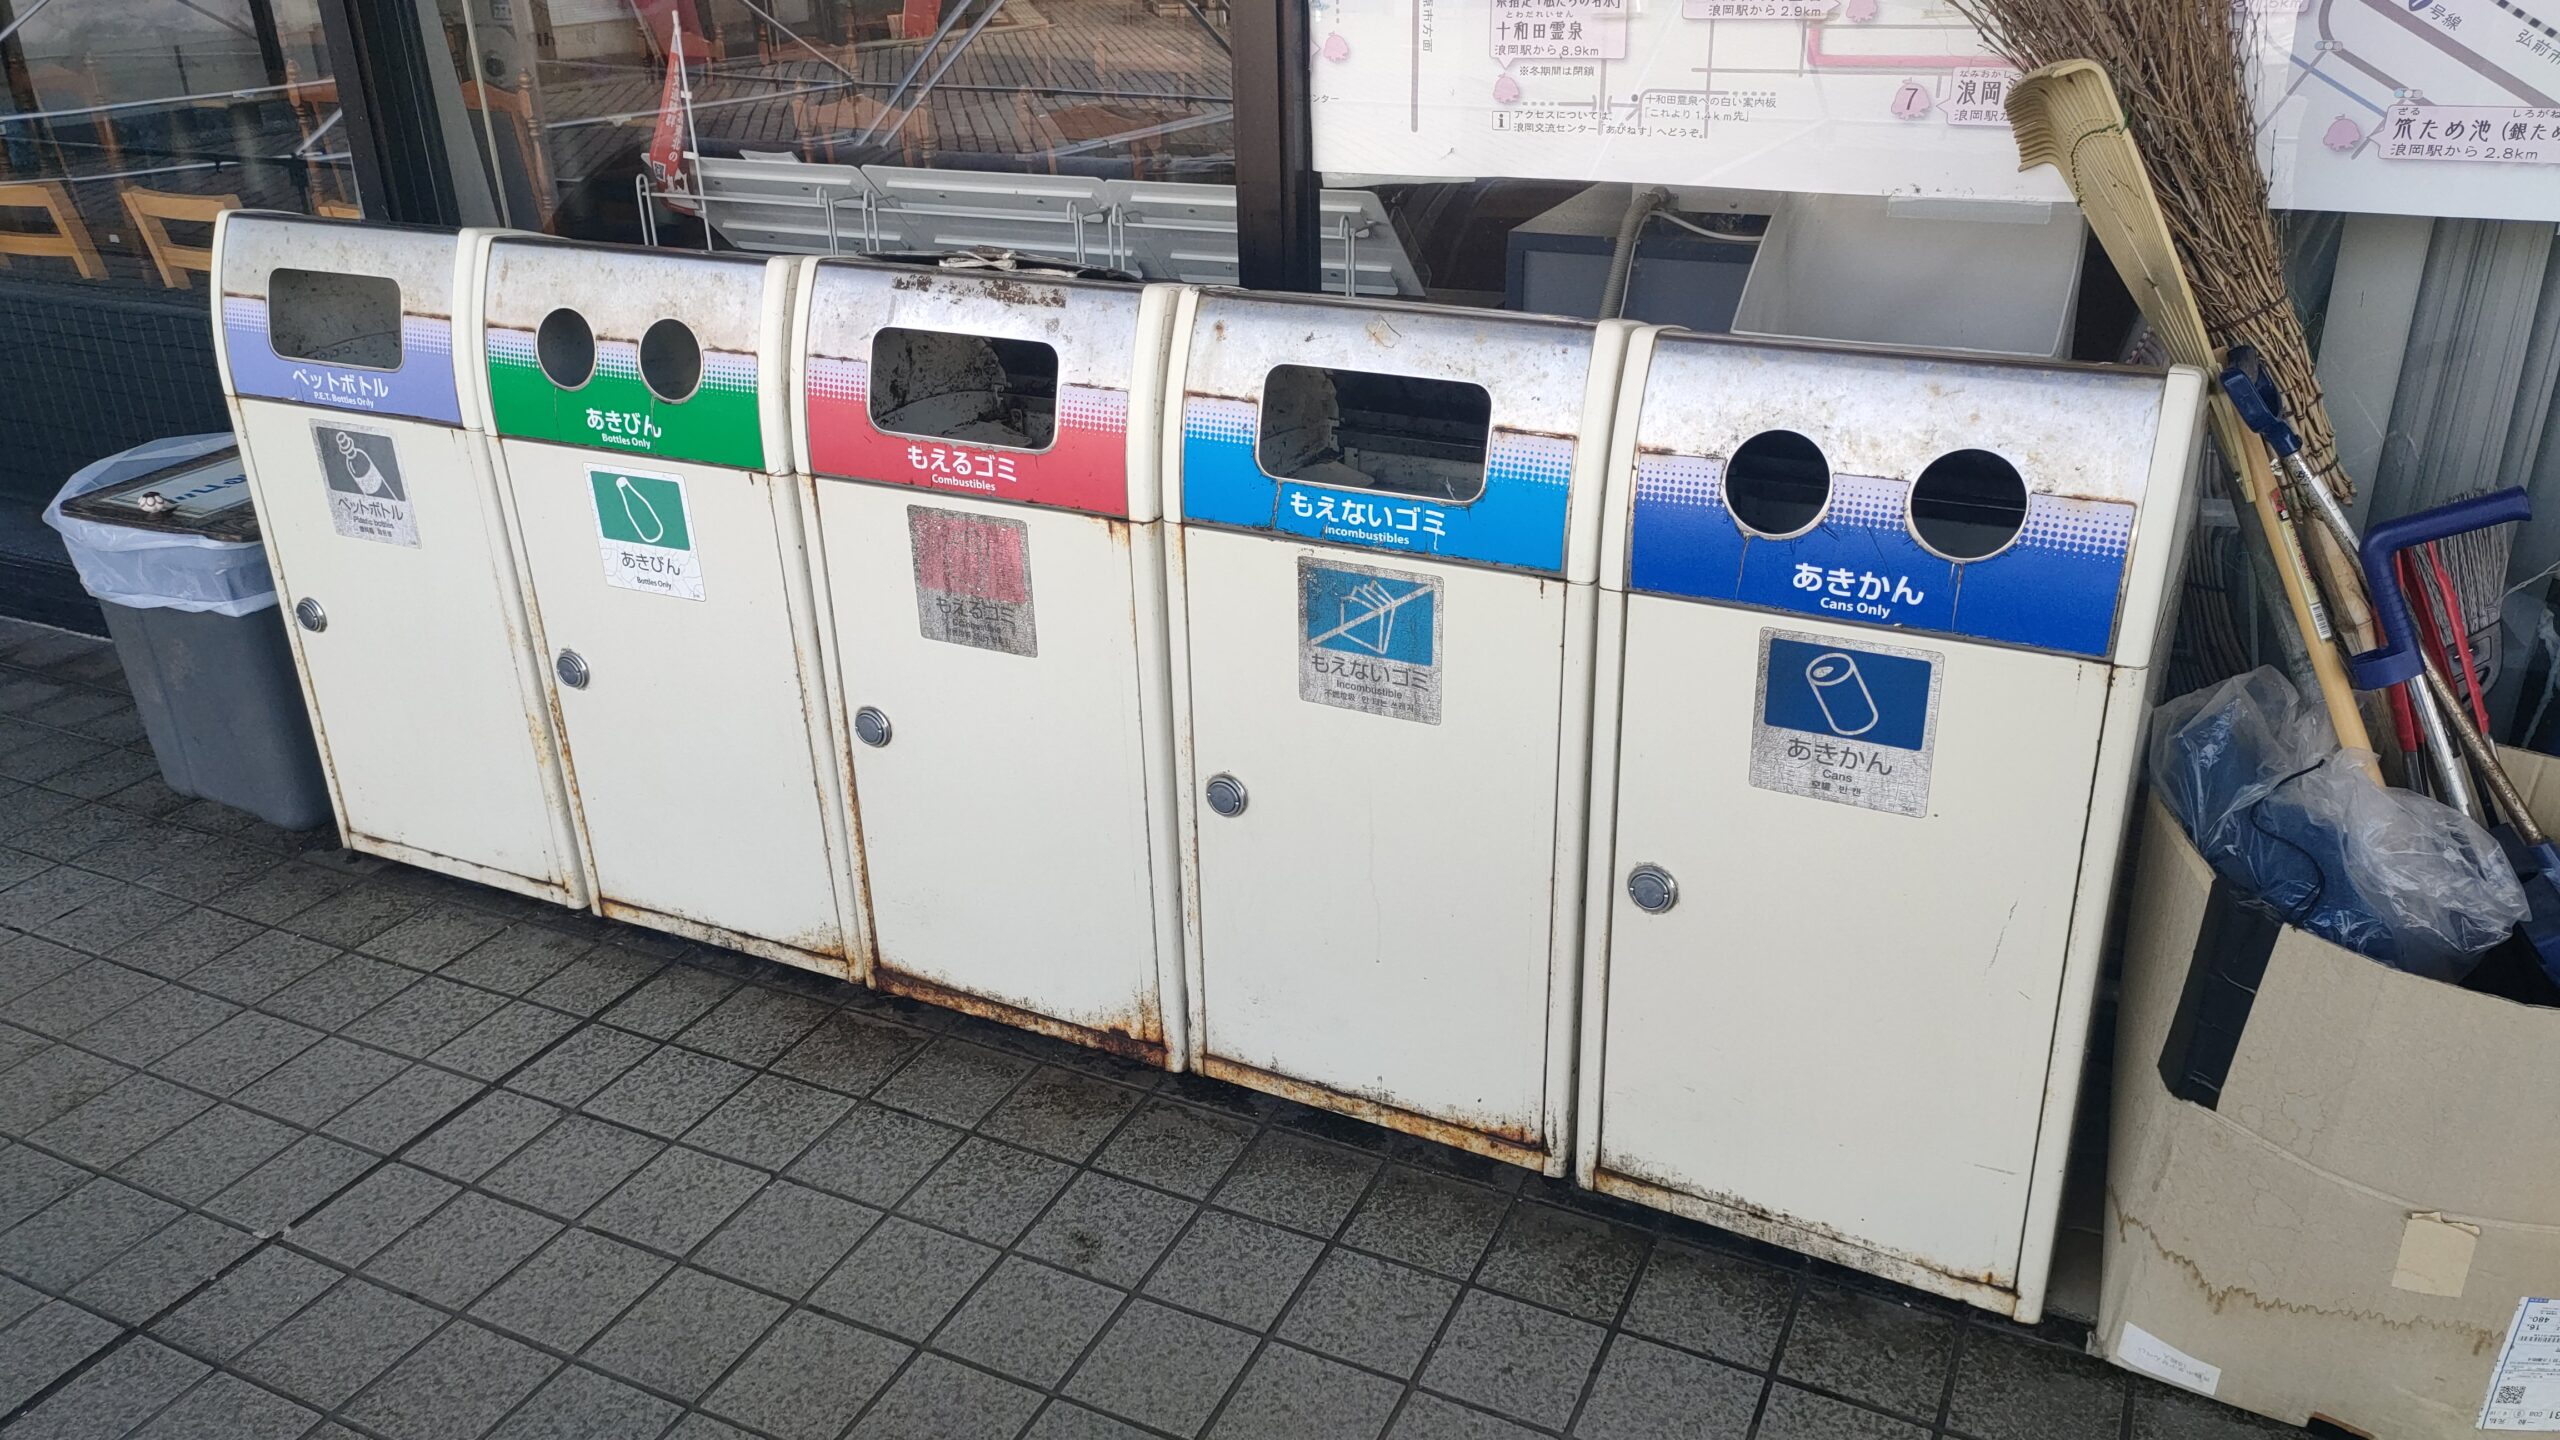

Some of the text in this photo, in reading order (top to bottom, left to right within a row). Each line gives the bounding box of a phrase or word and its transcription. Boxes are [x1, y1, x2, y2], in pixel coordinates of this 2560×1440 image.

[1505, 10, 1574, 19] とわだれいせん
[1708, 4, 1821, 17] 浪岡駅から 2.9km
[1496, 20, 1583, 41] 十和田霊泉
[1494, 44, 1599, 57] 浪岡駅から 8.9km
[1905, 87, 1918, 111] 7
[2390, 143, 2538, 160] 浪岡駅から 2.8km
[293, 368, 389, 398] ペットボトル
[314, 391, 332, 401] P.E.T.
[333, 394, 357, 405] Bottles
[586, 407, 662, 438] あきびん
[601, 433, 651, 450] Bottles Only
[907, 445, 1017, 482] もえるゴミ
[931, 474, 996, 492] Combustibles
[338, 497, 404, 521] ペットボトル
[1290, 491, 1446, 537] もえないゴミ
[621, 551, 681, 576] あきびん
[636, 577, 672, 591] Bottles Only
[1792, 562, 1925, 606] あきかん
[936, 595, 1016, 626] もえるゴミ
[1820, 597, 1891, 619] Cans Only
[1311, 653, 1429, 692] もえないゴミ
[1336, 679, 1403, 699] Incombustible
[1787, 737, 1893, 776] あきかん
[1822, 769, 1853, 783] Cans
